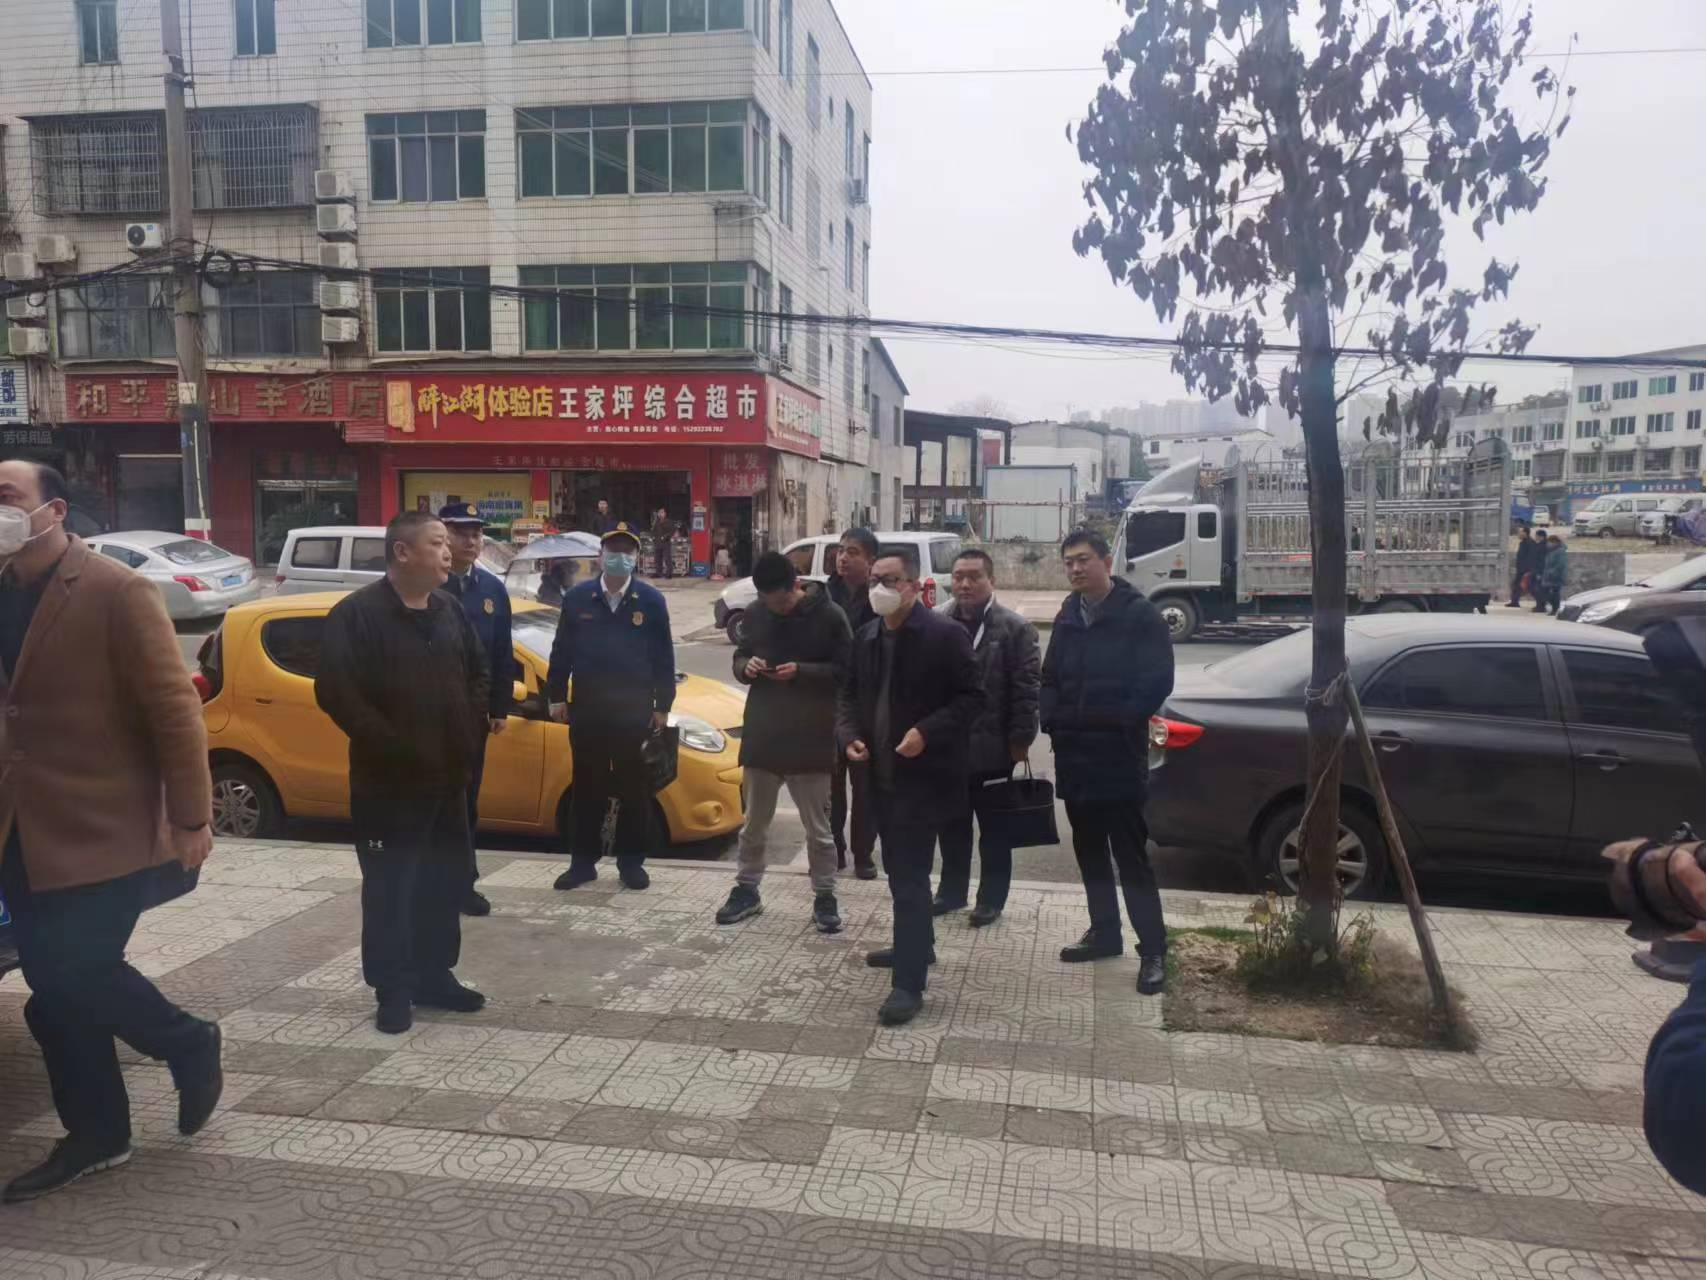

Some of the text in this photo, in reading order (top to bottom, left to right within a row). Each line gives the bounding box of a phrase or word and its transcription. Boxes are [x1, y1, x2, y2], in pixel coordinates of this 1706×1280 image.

[558, 384, 758, 420] 王家坪综合超市
